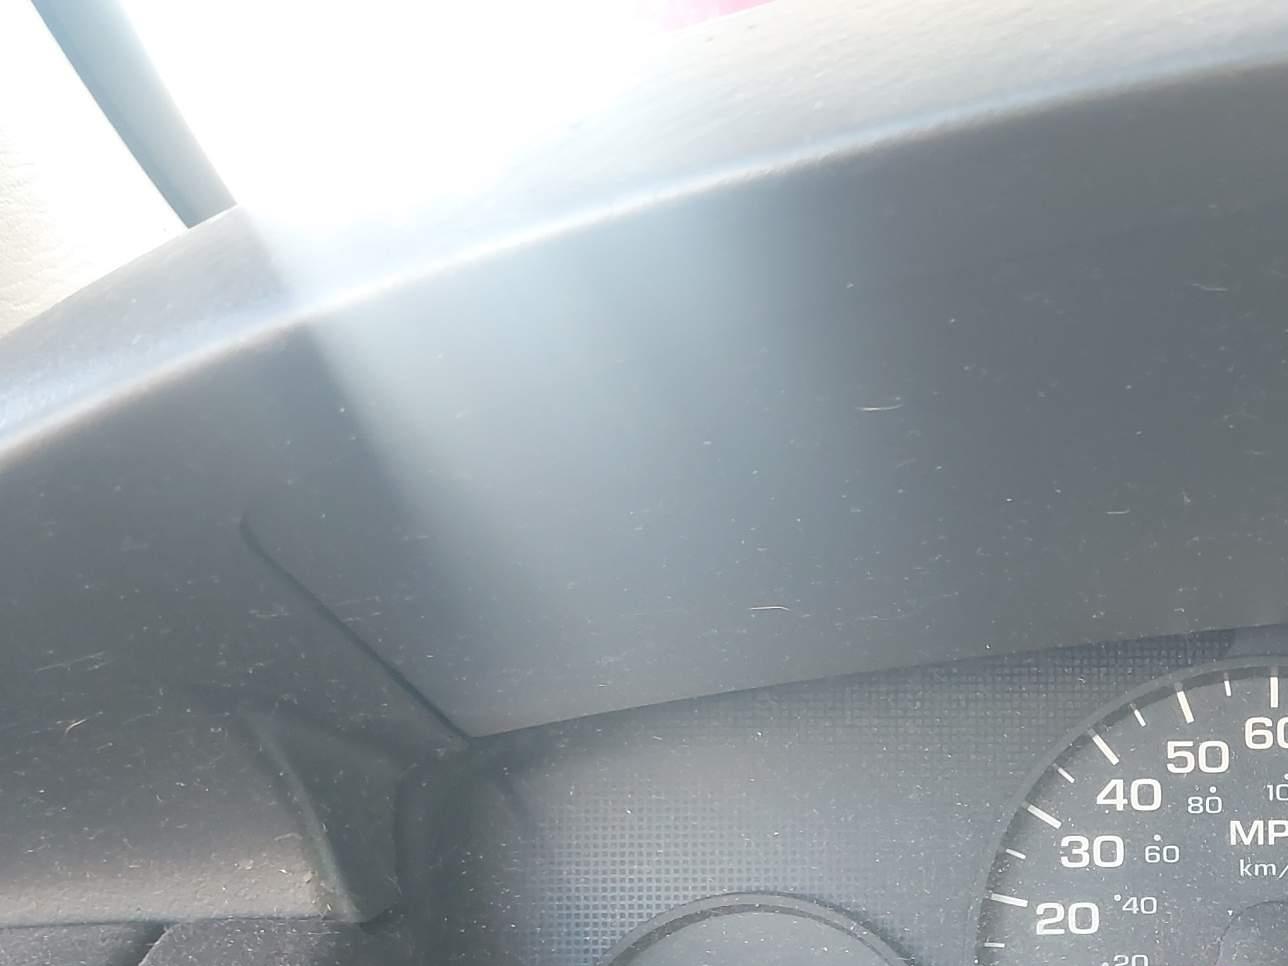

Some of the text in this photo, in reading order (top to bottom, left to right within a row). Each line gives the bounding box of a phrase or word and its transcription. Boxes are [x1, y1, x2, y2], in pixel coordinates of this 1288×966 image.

[1166, 740, 1230, 774] 50
[1096, 778, 1162, 812] 40
[1186, 796, 1223, 815] 80
[1060, 834, 1124, 868] 30
[1144, 844, 1180, 864] 60
[1035, 902, 1099, 936] 20
[1122, 896, 1158, 916] 40
